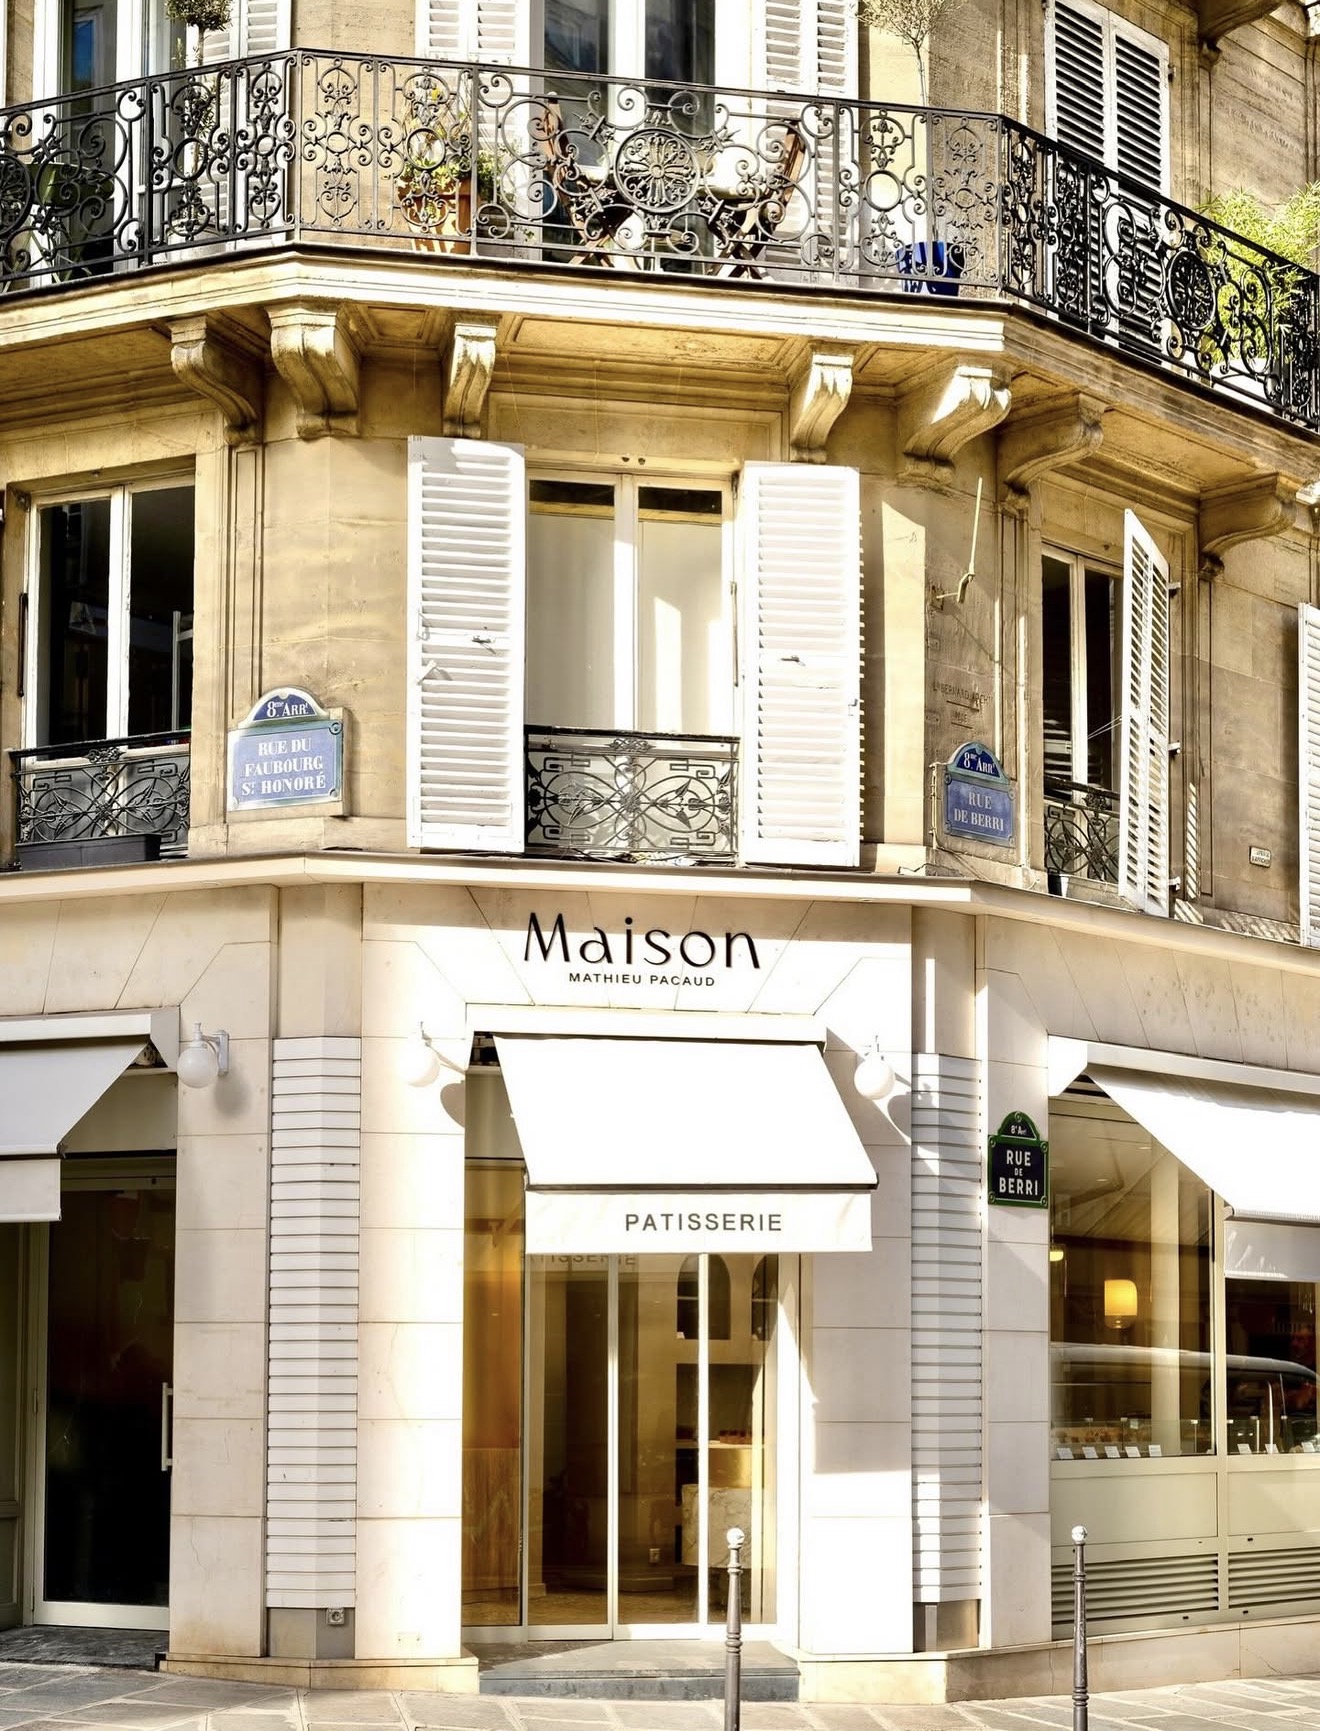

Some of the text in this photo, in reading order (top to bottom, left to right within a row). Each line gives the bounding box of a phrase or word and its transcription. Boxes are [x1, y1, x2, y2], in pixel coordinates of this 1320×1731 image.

[258, 738, 311, 756] RUE DU
[244, 756, 322, 777] FAUBOURG
[261, 772, 326, 794] HONORÉ
[968, 791, 993, 810] RUE
[953, 807, 1004, 832] DE BERRI
[524, 912, 760, 969] Maison
[569, 973, 716, 987] MATHIEU PACAUD
[1006, 1150, 1031, 1166] RUE
[1014, 1167, 1023, 1177] DE
[999, 1177, 1038, 1195] BERRI
[625, 1213, 782, 1232] PATISSERIE
